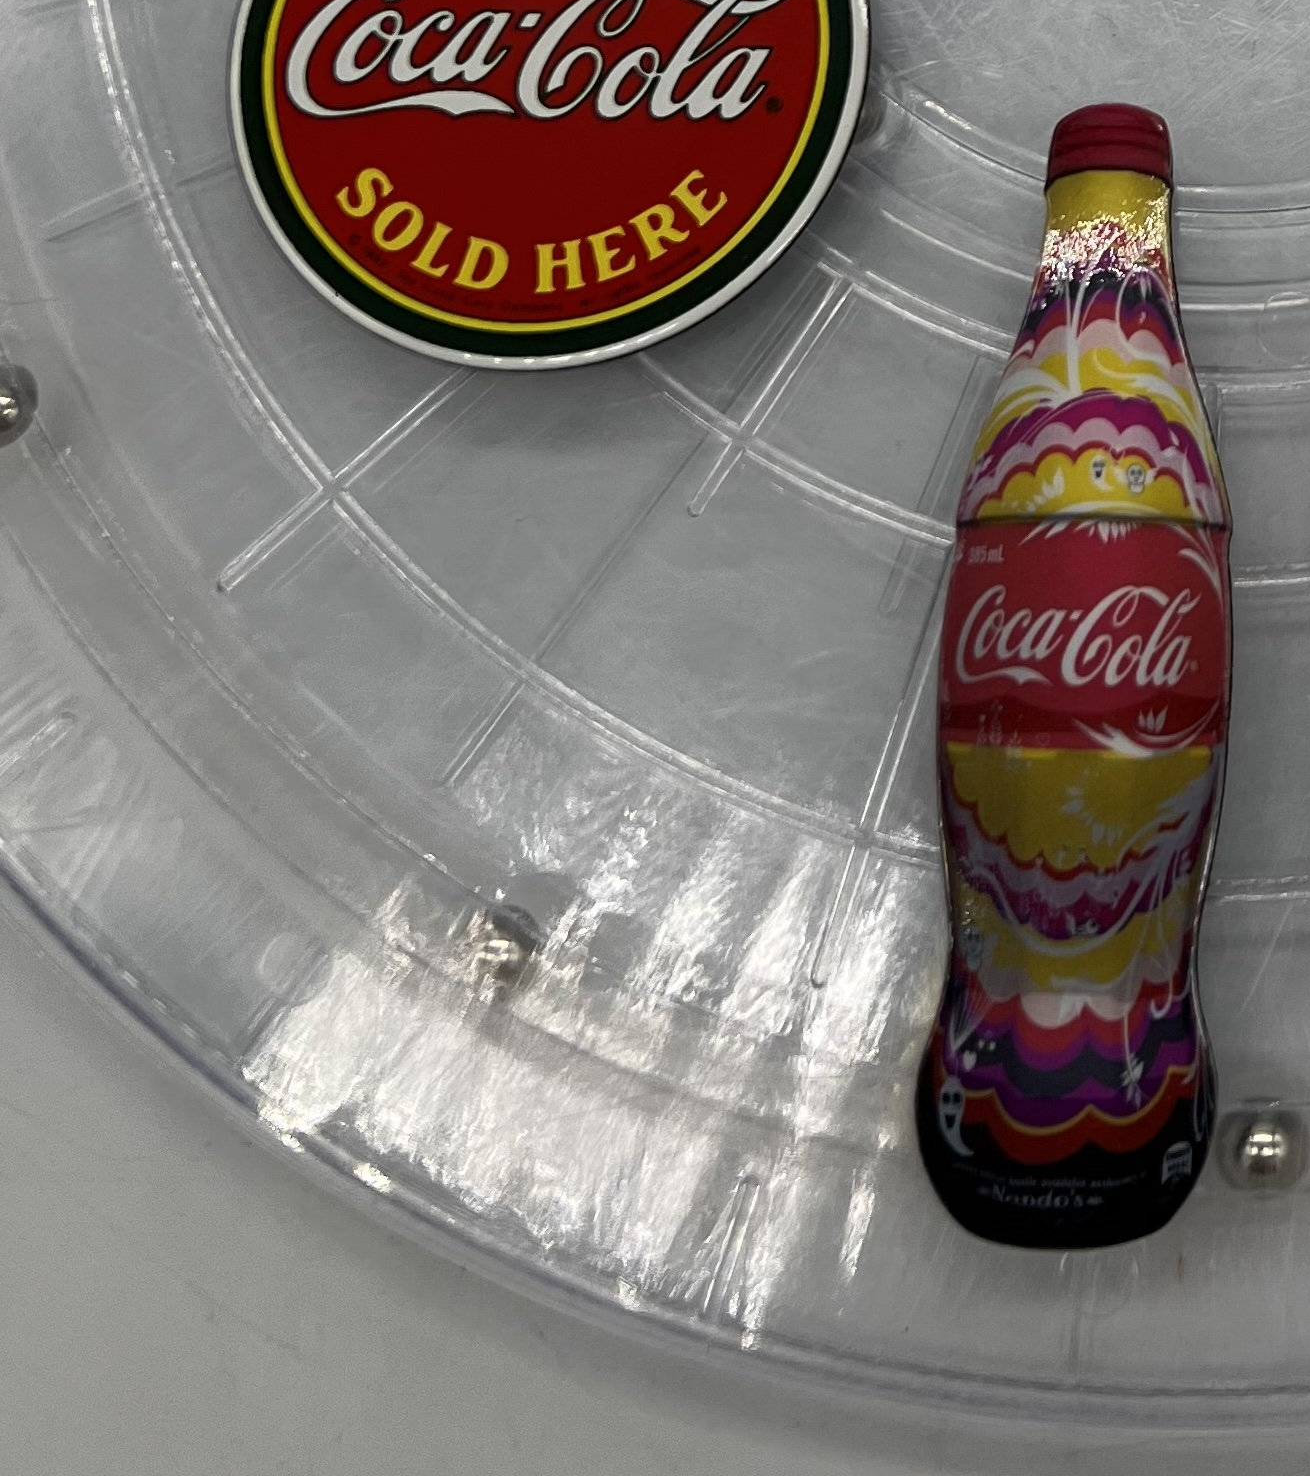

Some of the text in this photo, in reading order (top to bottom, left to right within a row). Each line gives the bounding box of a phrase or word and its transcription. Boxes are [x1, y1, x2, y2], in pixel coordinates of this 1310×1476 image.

[336, 167, 510, 293] SOLD
[534, 170, 728, 295] HERE
[956, 584, 1202, 687] Coca-Cola
